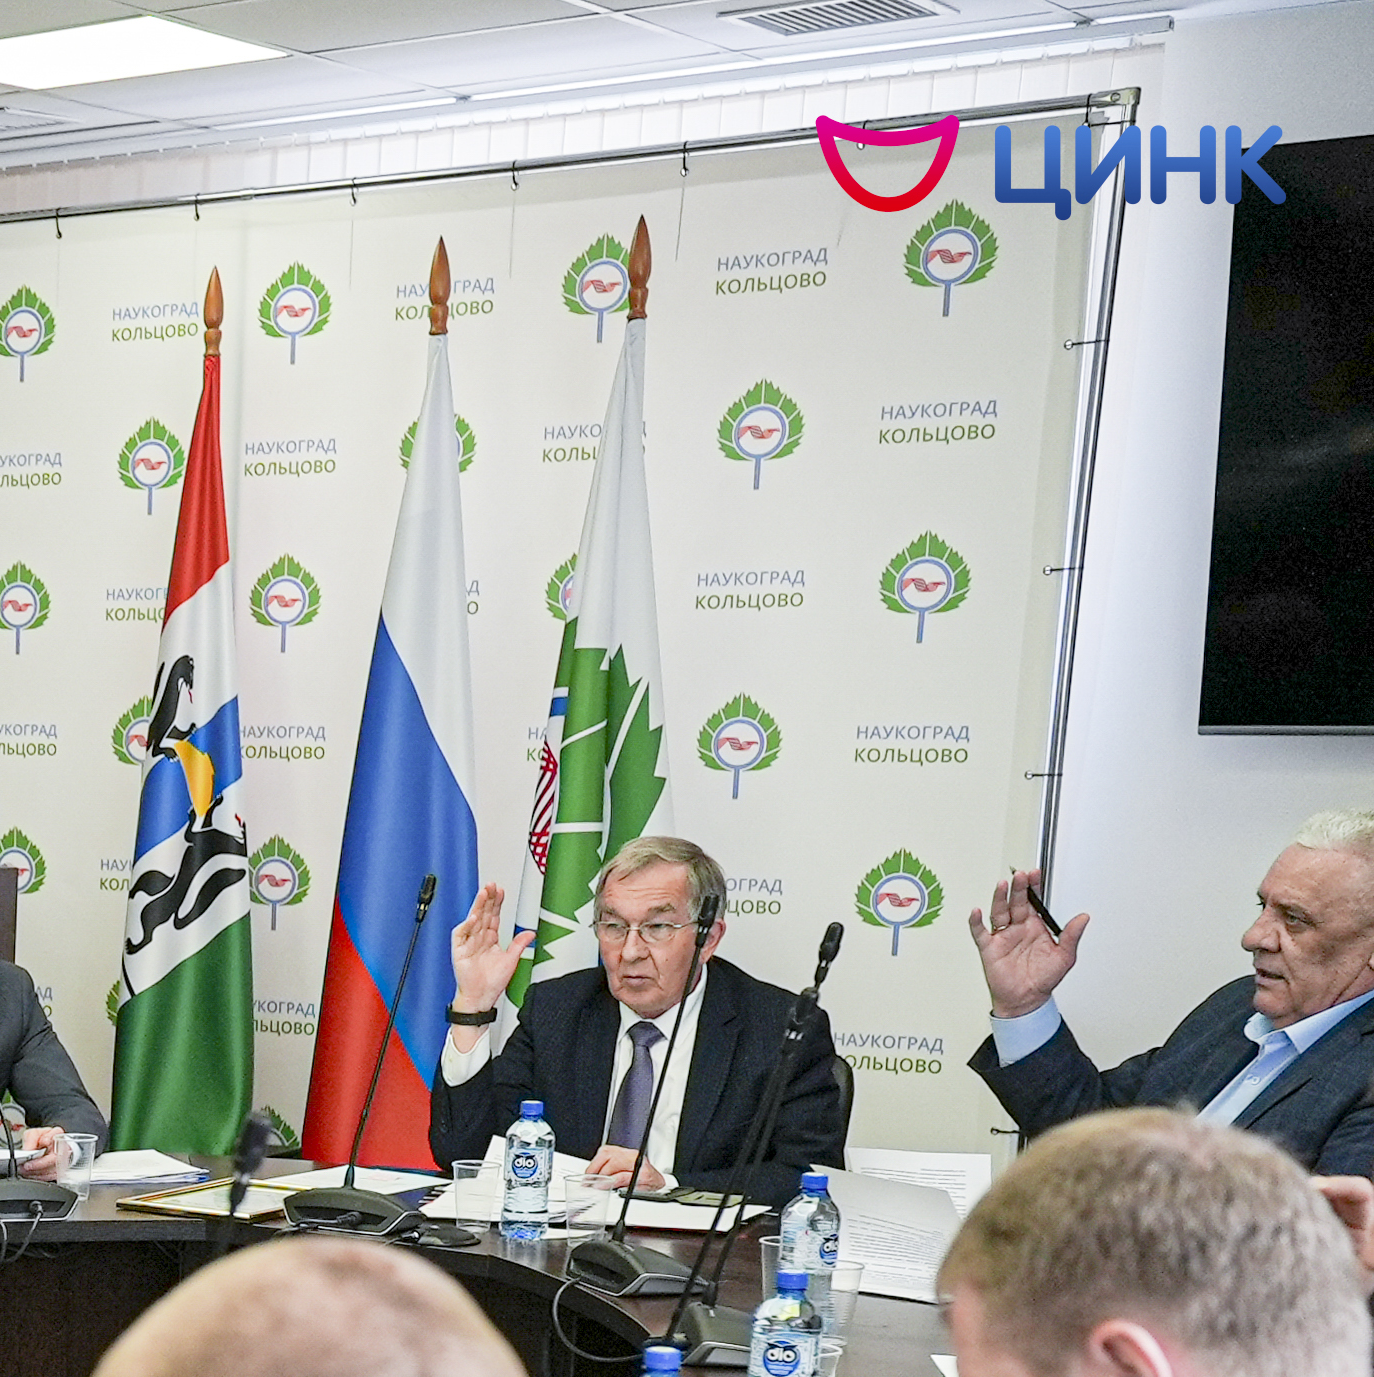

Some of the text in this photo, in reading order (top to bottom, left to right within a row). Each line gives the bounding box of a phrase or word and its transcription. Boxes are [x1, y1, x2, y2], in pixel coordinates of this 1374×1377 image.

[716, 248, 829, 272] НАУКОГРАД
[396, 278, 496, 299] НАУГРАД
[715, 271, 827, 296] КОЛЬЦОВО
[112, 301, 200, 322] НАУКОГРАД
[111, 322, 199, 342] КОЛЬЦОВО
[880, 400, 998, 421] НАУКОГРАД
[878, 424, 996, 445] КОЛЬЦОВО
[244, 438, 338, 457] НАУКОГРАД
[243, 459, 336, 478] КОЛЬЦОВО
[696, 569, 806, 588] НАУКОГРАД
[695, 592, 804, 612] КОЛЬЦОВО
[105, 607, 166, 623] КОЛЬЦО
[855, 725, 971, 744] НАУКОГРАД
[240, 745, 325, 762] ОЛЬЦОВО
[854, 747, 969, 767] КОЛЬЦОВО
[725, 878, 783, 896] ОГРАД
[832, 1032, 944, 1056] НАУКОГРАД
[844, 1053, 942, 1076] ОЛЬЦОВО
